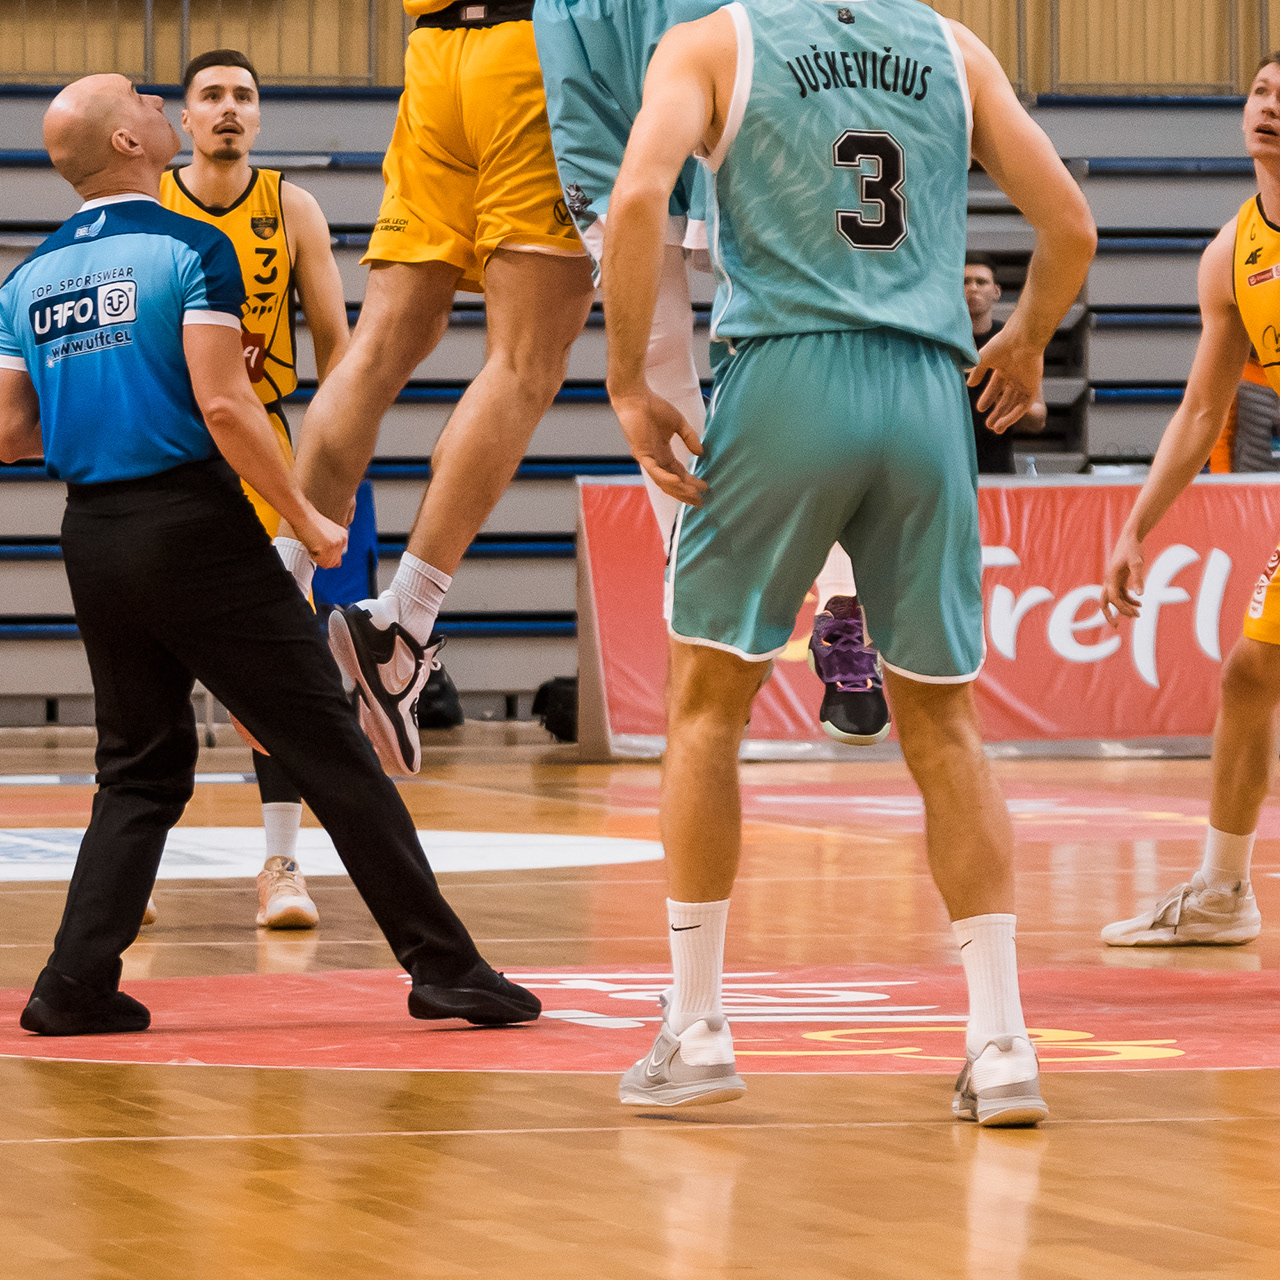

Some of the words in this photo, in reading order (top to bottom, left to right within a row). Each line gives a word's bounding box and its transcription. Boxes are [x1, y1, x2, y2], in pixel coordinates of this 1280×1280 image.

[787, 45, 933, 102] JUŠKEVIČIUS
[833, 129, 907, 252] 3
[32, 284, 53, 300] TOP
[60, 267, 134, 291] SPORTSWEAR
[253, 247, 278, 285] 3
